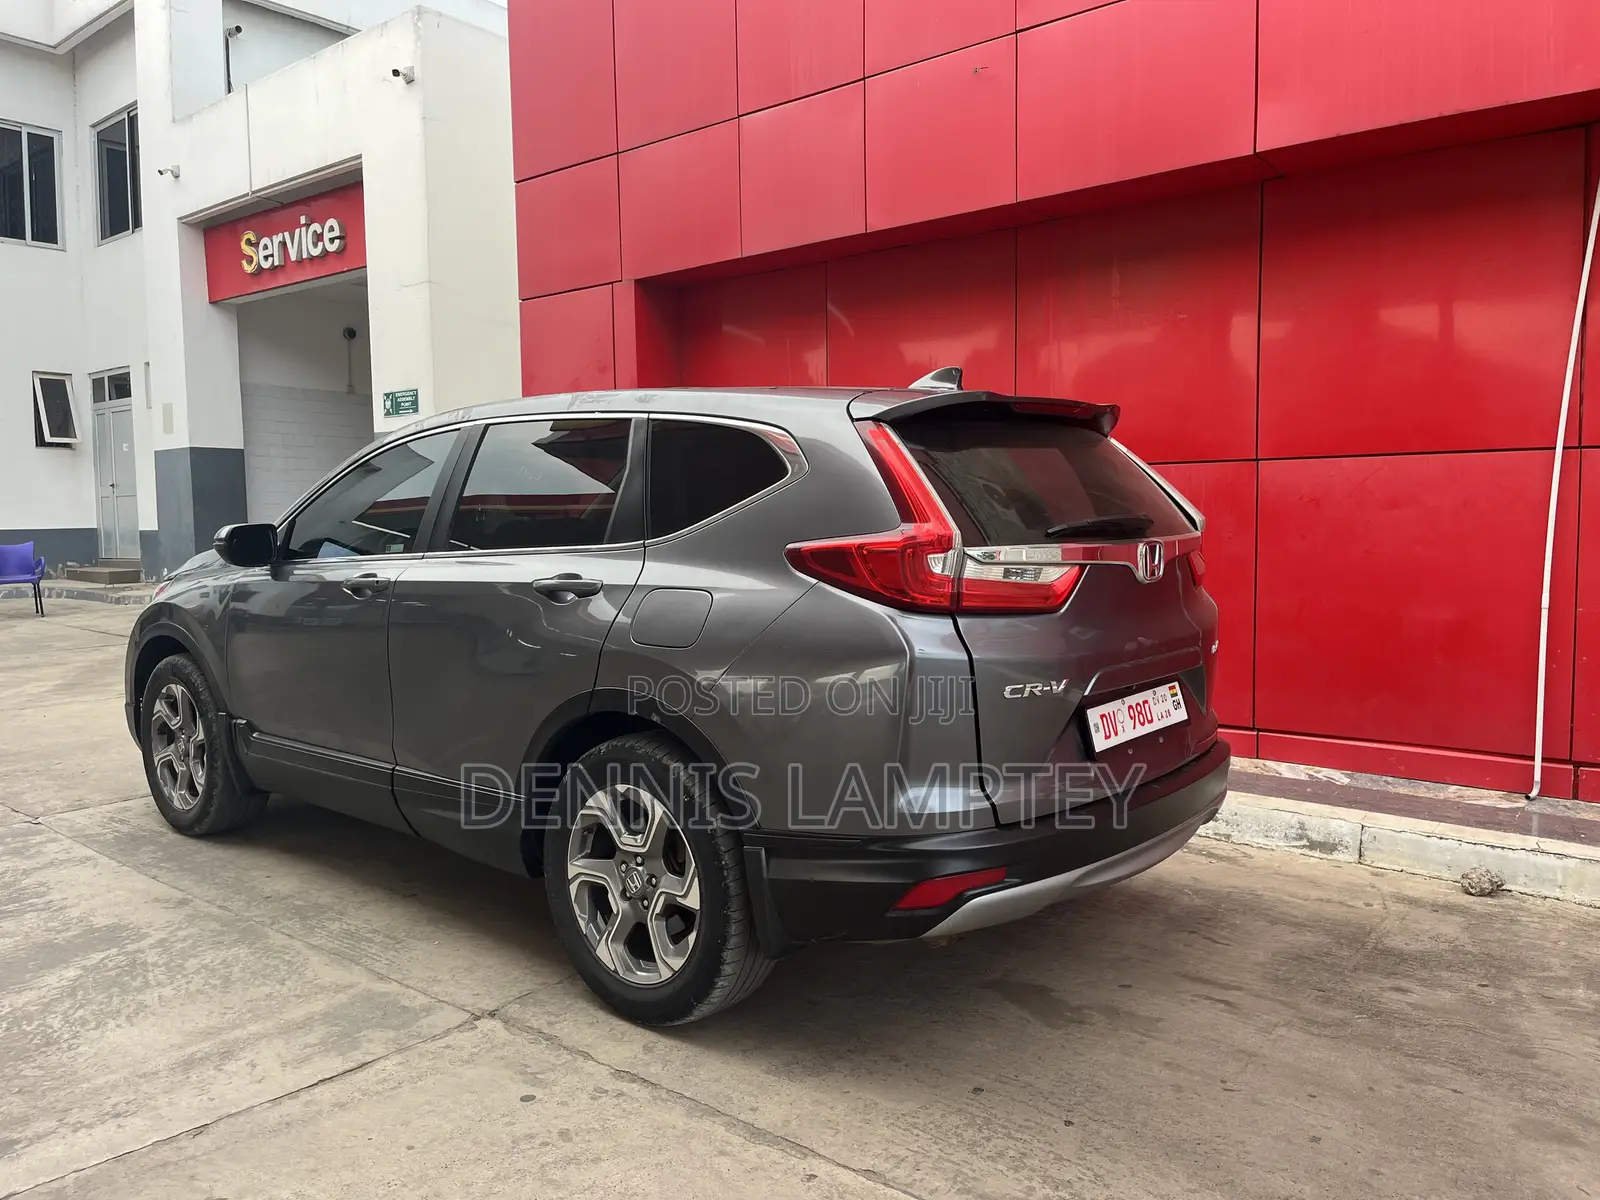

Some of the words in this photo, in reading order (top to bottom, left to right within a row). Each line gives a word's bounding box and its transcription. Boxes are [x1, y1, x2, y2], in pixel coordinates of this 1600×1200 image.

[240, 215, 345, 274] Service
[1003, 679, 1069, 700] CR-V
[1172, 698, 1182, 711] GH
[1099, 710, 1118, 740] DV
[1127, 699, 1154, 730] 980
